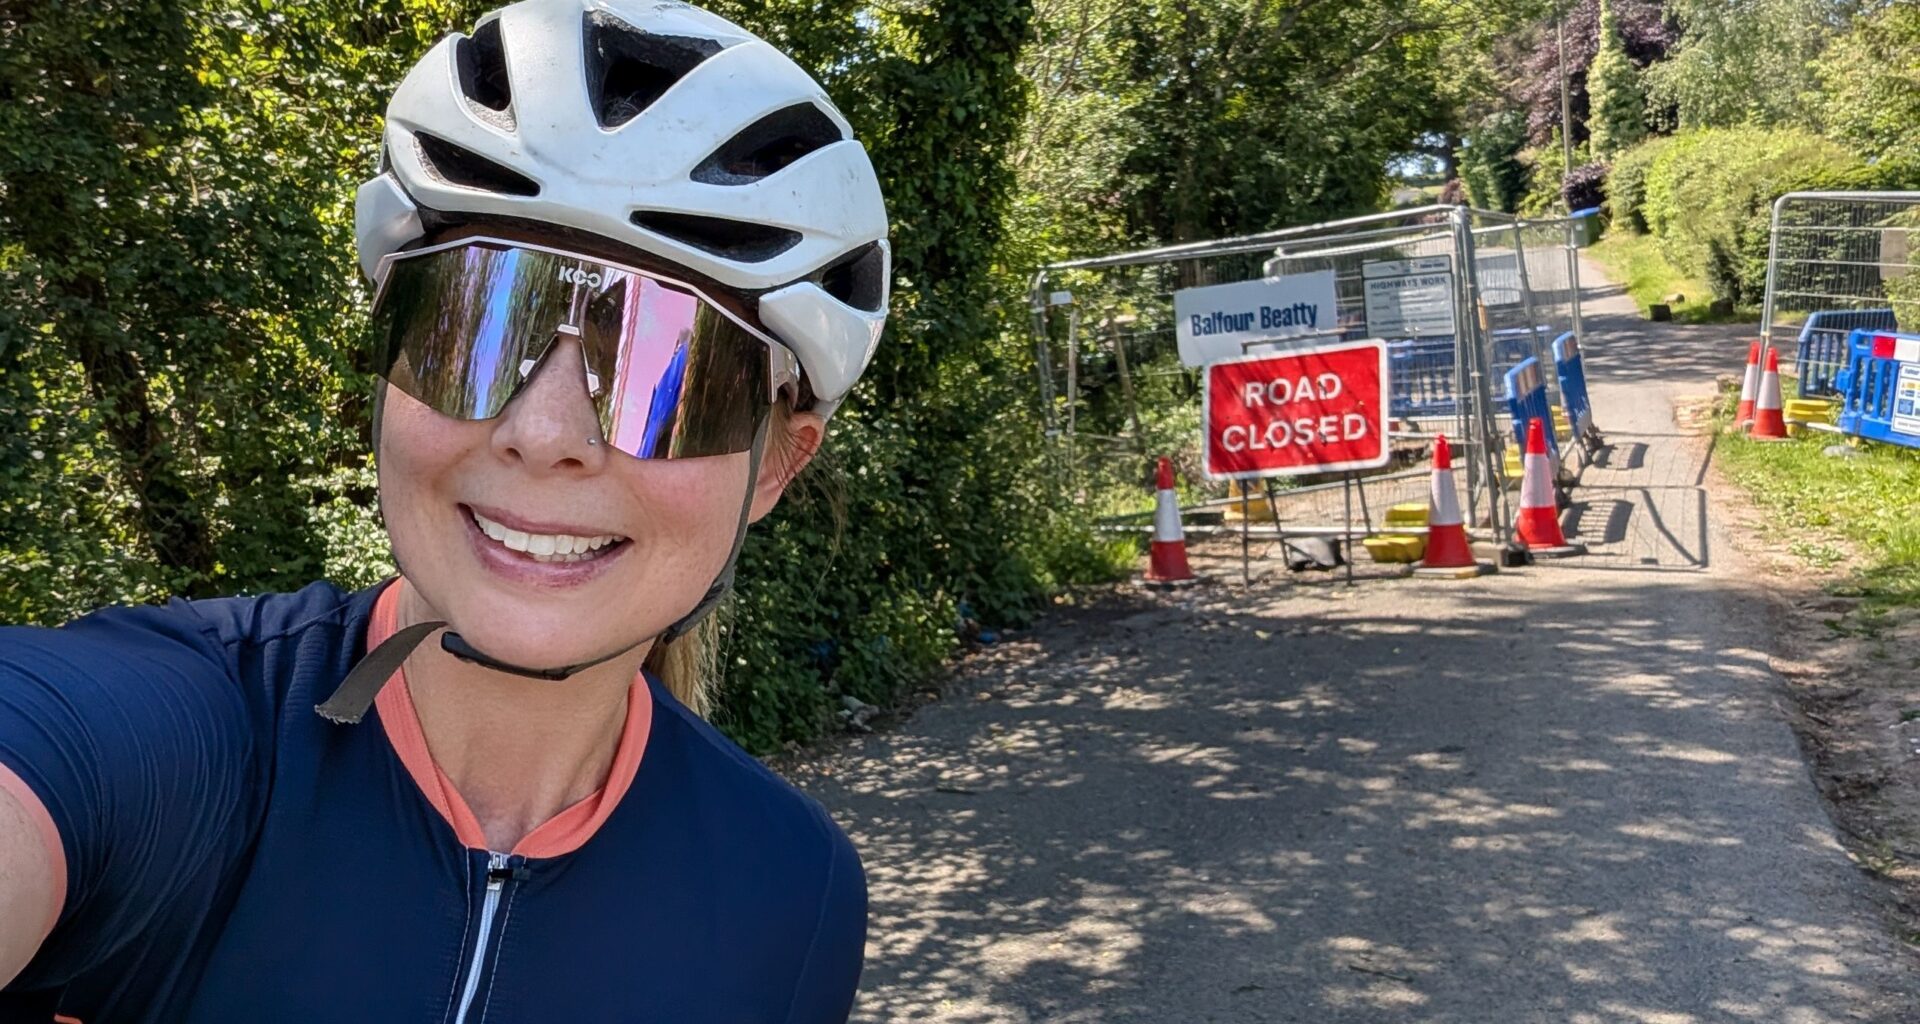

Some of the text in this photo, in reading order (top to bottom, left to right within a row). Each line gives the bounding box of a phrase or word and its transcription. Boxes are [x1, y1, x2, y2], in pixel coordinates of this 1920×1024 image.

[559, 265, 602, 288] KOO
[1370, 276, 1446, 290] HIGHWAYS WORK
[1191, 302, 1317, 336] Balfour Beatty
[1244, 372, 1342, 408] ROAD
[1222, 413, 1367, 453] CLOSED
